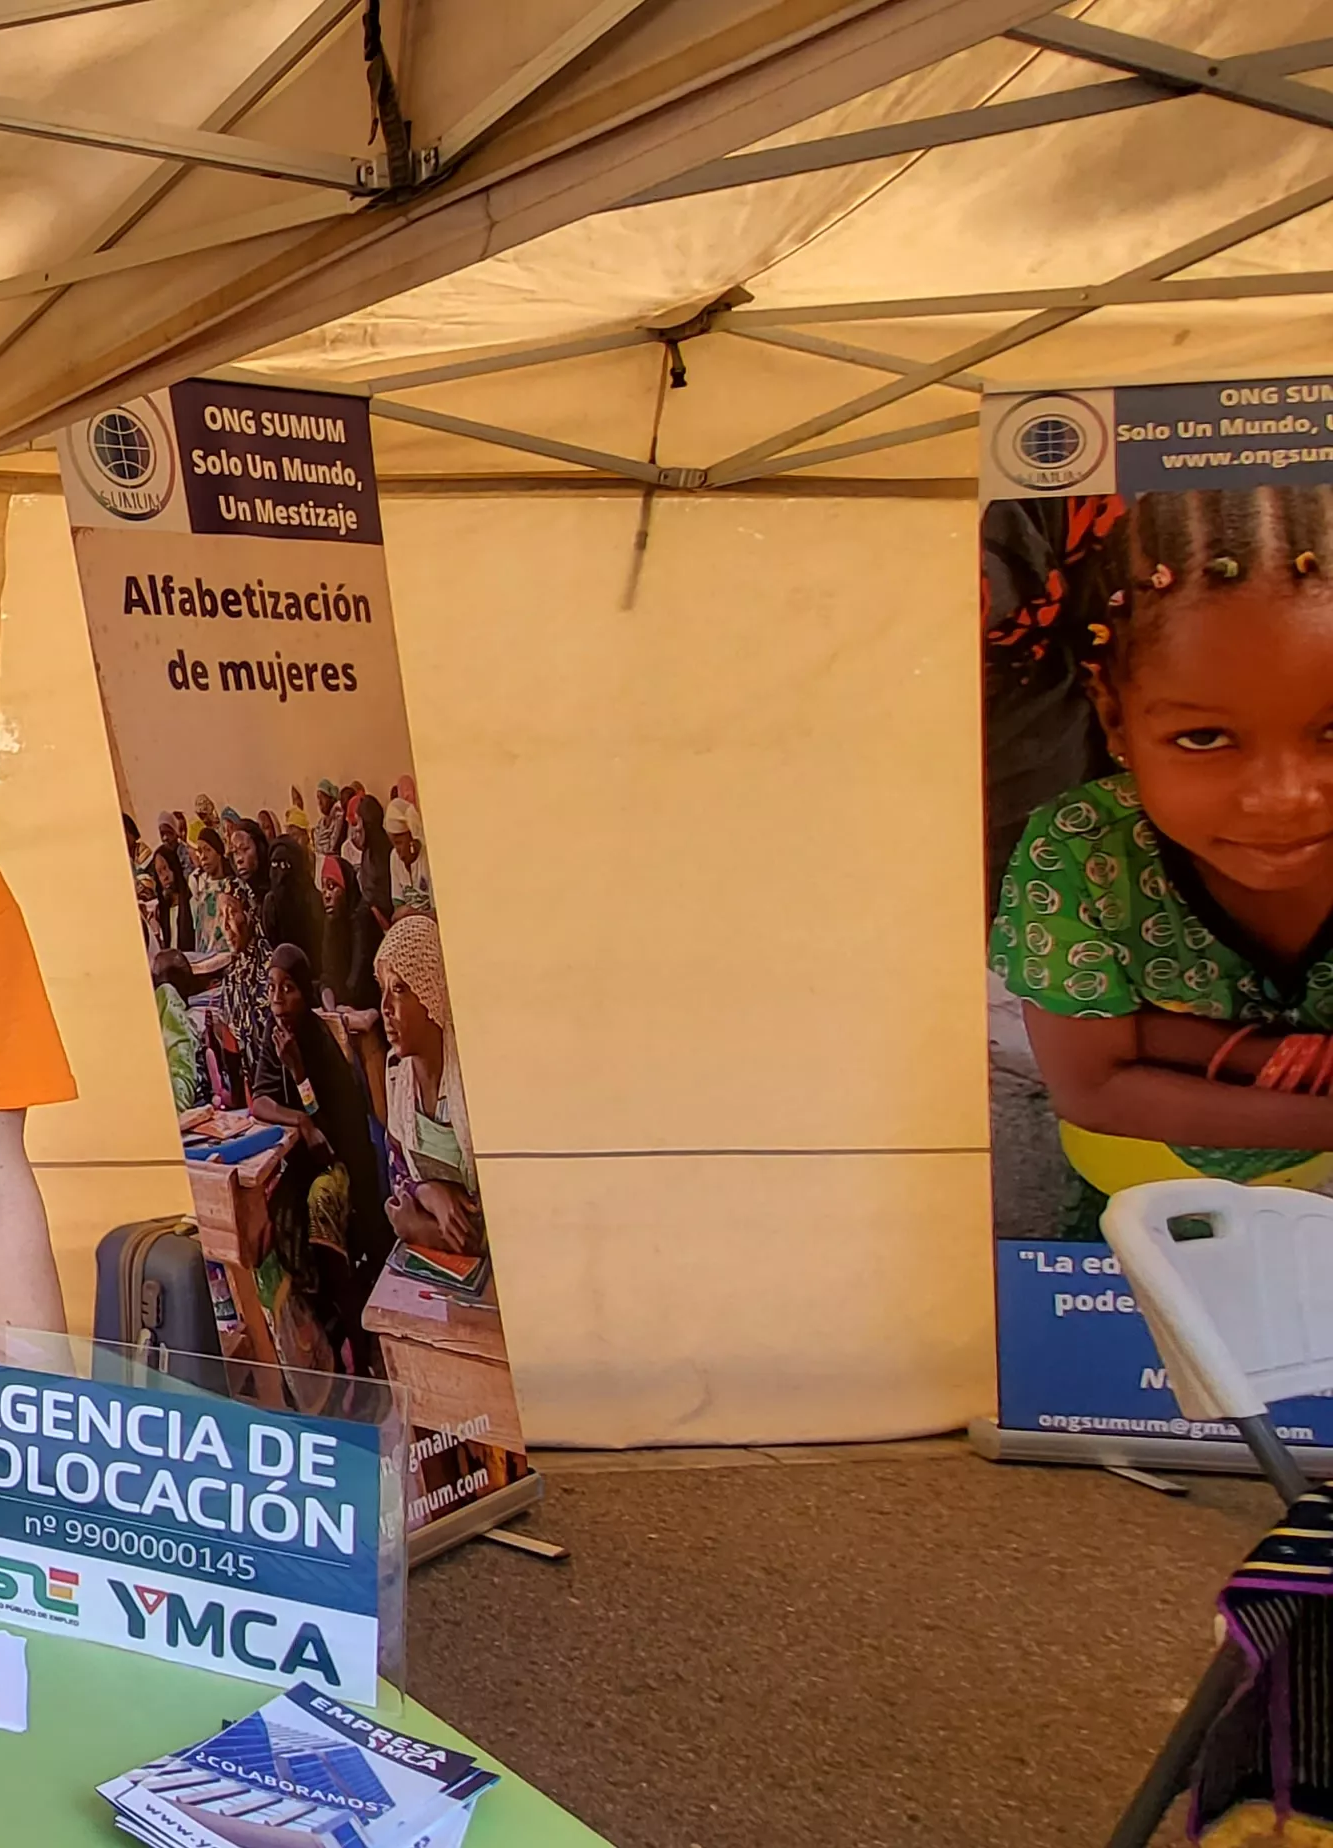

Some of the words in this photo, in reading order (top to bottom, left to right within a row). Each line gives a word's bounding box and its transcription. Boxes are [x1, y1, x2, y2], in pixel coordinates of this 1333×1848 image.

[1220, 387, 1279, 406] ONG
[204, 405, 257, 435] ONG
[262, 411, 346, 443] SUMUM
[1117, 423, 1170, 441] Solo
[1178, 421, 1213, 437] Un
[1219, 415, 1319, 437] Mundo,
[191, 448, 241, 476] Solo
[247, 453, 278, 481] Un
[283, 457, 363, 491] Mundo,
[218, 495, 252, 522] Un
[256, 499, 358, 535] Mestizaje
[123, 573, 372, 624] Alfabetización
[167, 649, 209, 692] de
[219, 651, 358, 703] mujeres
[1082, 1253, 1122, 1275] ed
[248, 1423, 338, 1490] DE
[66, 1520, 257, 1582] 9900000145
[107, 1578, 343, 1687] YMCA
[310, 1696, 448, 1763] EMPRESA
[367, 1735, 438, 1771] YMCA
[195, 1750, 391, 1814] ¿COLABORAMOS?
[145, 1803, 219, 1848] www.y
